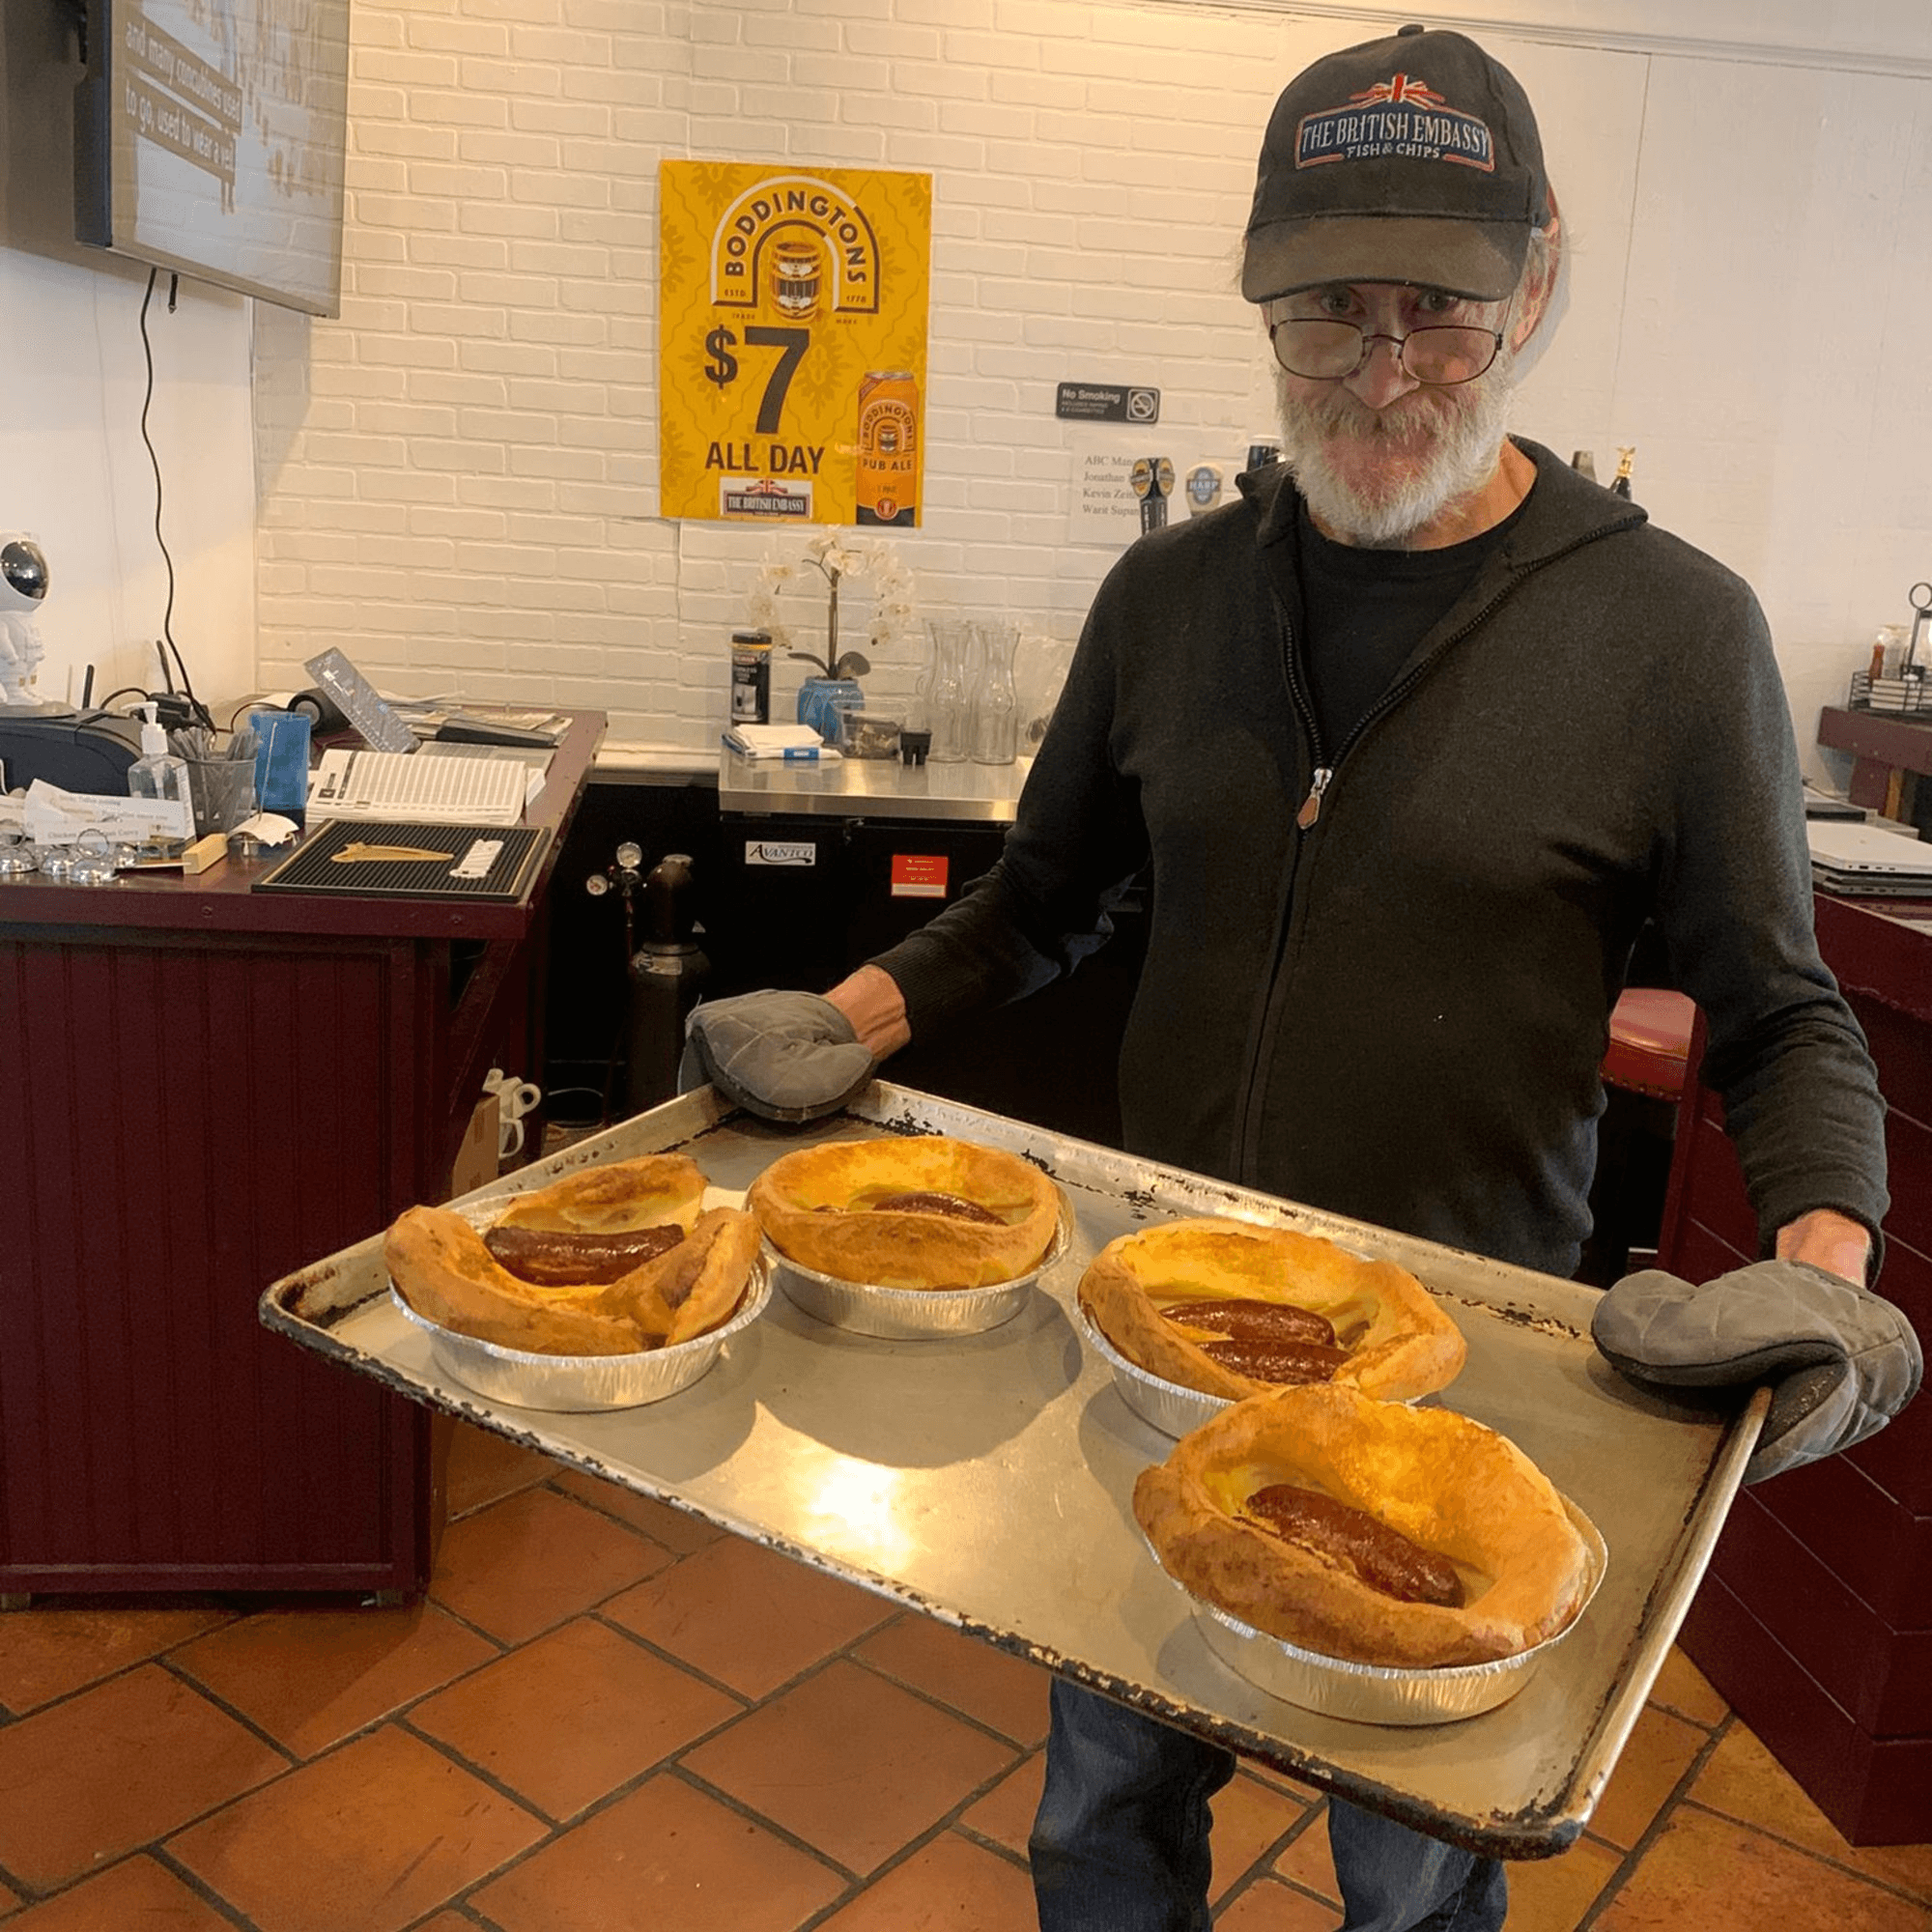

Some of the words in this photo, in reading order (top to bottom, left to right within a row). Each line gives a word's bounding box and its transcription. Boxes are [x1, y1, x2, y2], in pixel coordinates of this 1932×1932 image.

[126, 21, 145, 57] and
[149, 38, 175, 86] many
[126, 78, 137, 116] to
[157, 107, 180, 141] used
[182, 112, 191, 148] to
[1301, 120, 1335, 153] THE
[1336, 112, 1409, 145] BRITISH
[1413, 114, 1490, 156] EMBASSY
[1347, 142, 1381, 158] FISH
[1381, 141, 1395, 155] &
[1395, 142, 1441, 158] CHIPS
[724, 190, 867, 283] BODDINGTONS
[1063, 388, 1077, 400] No
[1078, 389, 1122, 405] Smoking
[704, 441, 760, 471] ALL
[769, 444, 826, 474] DAY
[862, 458, 887, 470] PUB
[890, 459, 913, 471] ALE
[727, 496, 743, 509] THE
[743, 497, 772, 511] BRITISH
[773, 497, 805, 512] EMBASSY
[1082, 487, 1111, 498] Kevin
